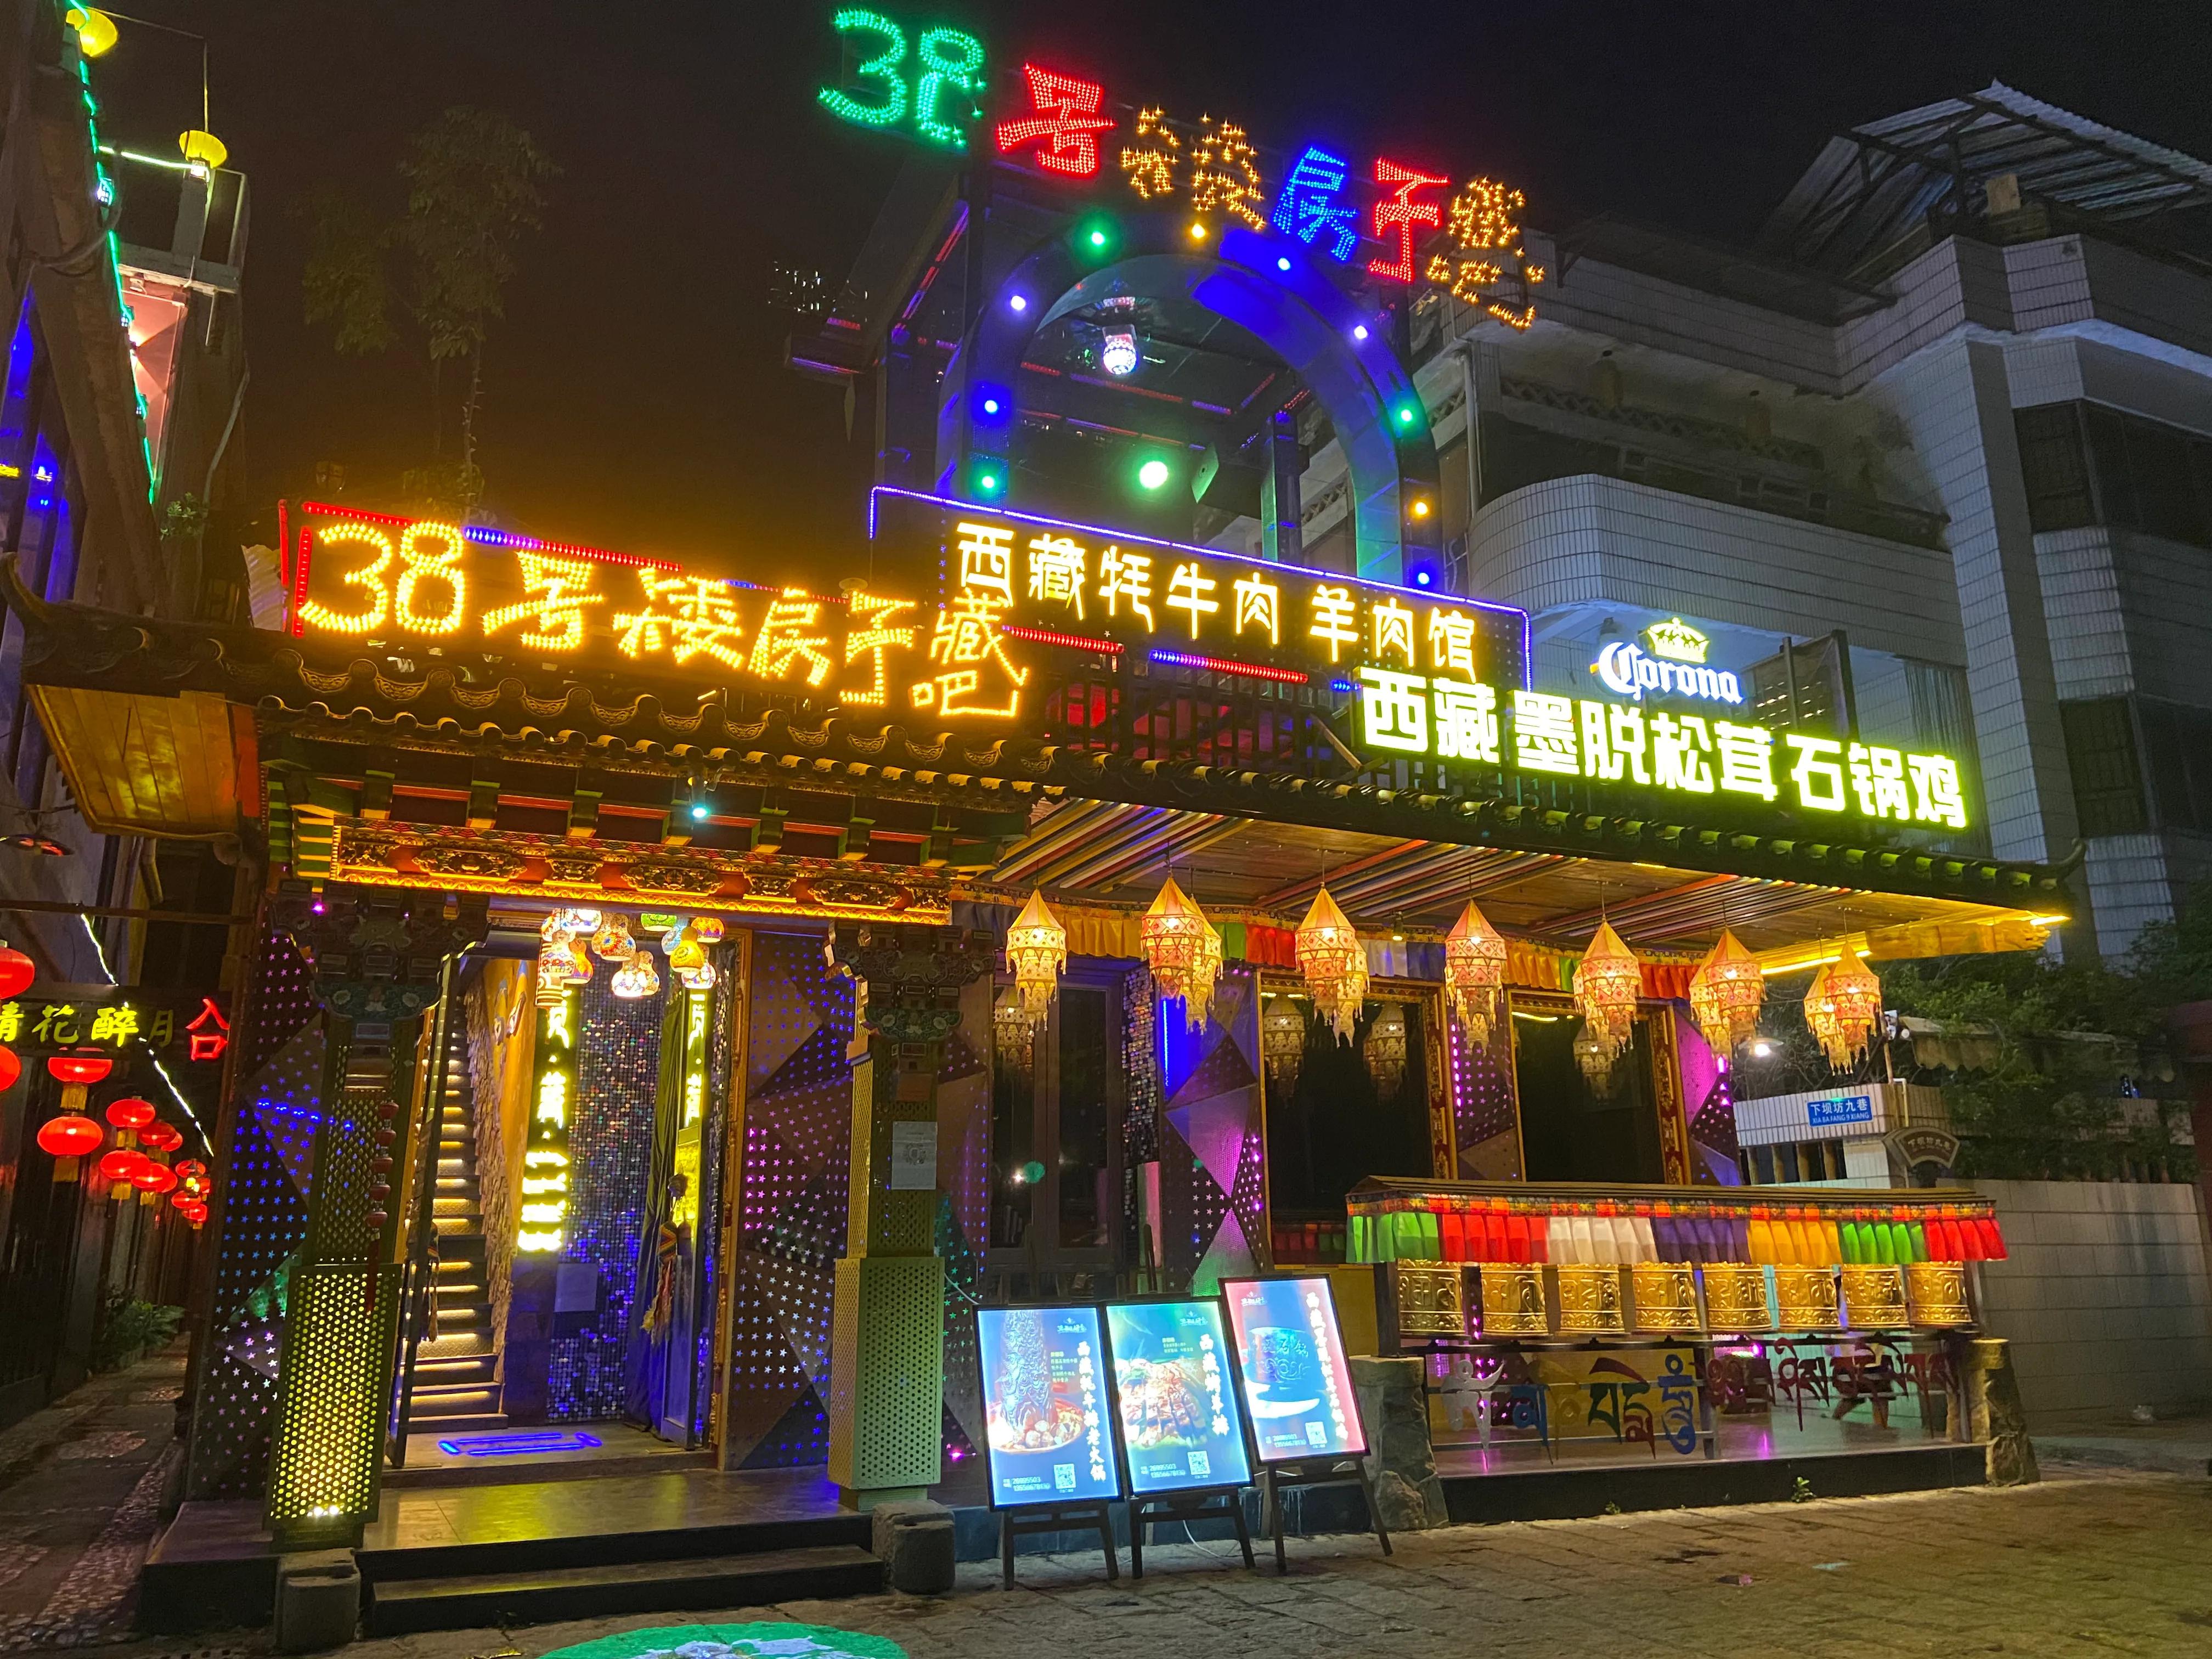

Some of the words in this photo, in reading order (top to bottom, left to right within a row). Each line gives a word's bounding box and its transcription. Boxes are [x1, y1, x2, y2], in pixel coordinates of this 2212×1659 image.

[1598, 641, 1745, 704] Corona
[1359, 666, 1968, 829] 西藏墨脱松茸石锅鸡
[1810, 1098, 1867, 1116] 下坝坊九巷
